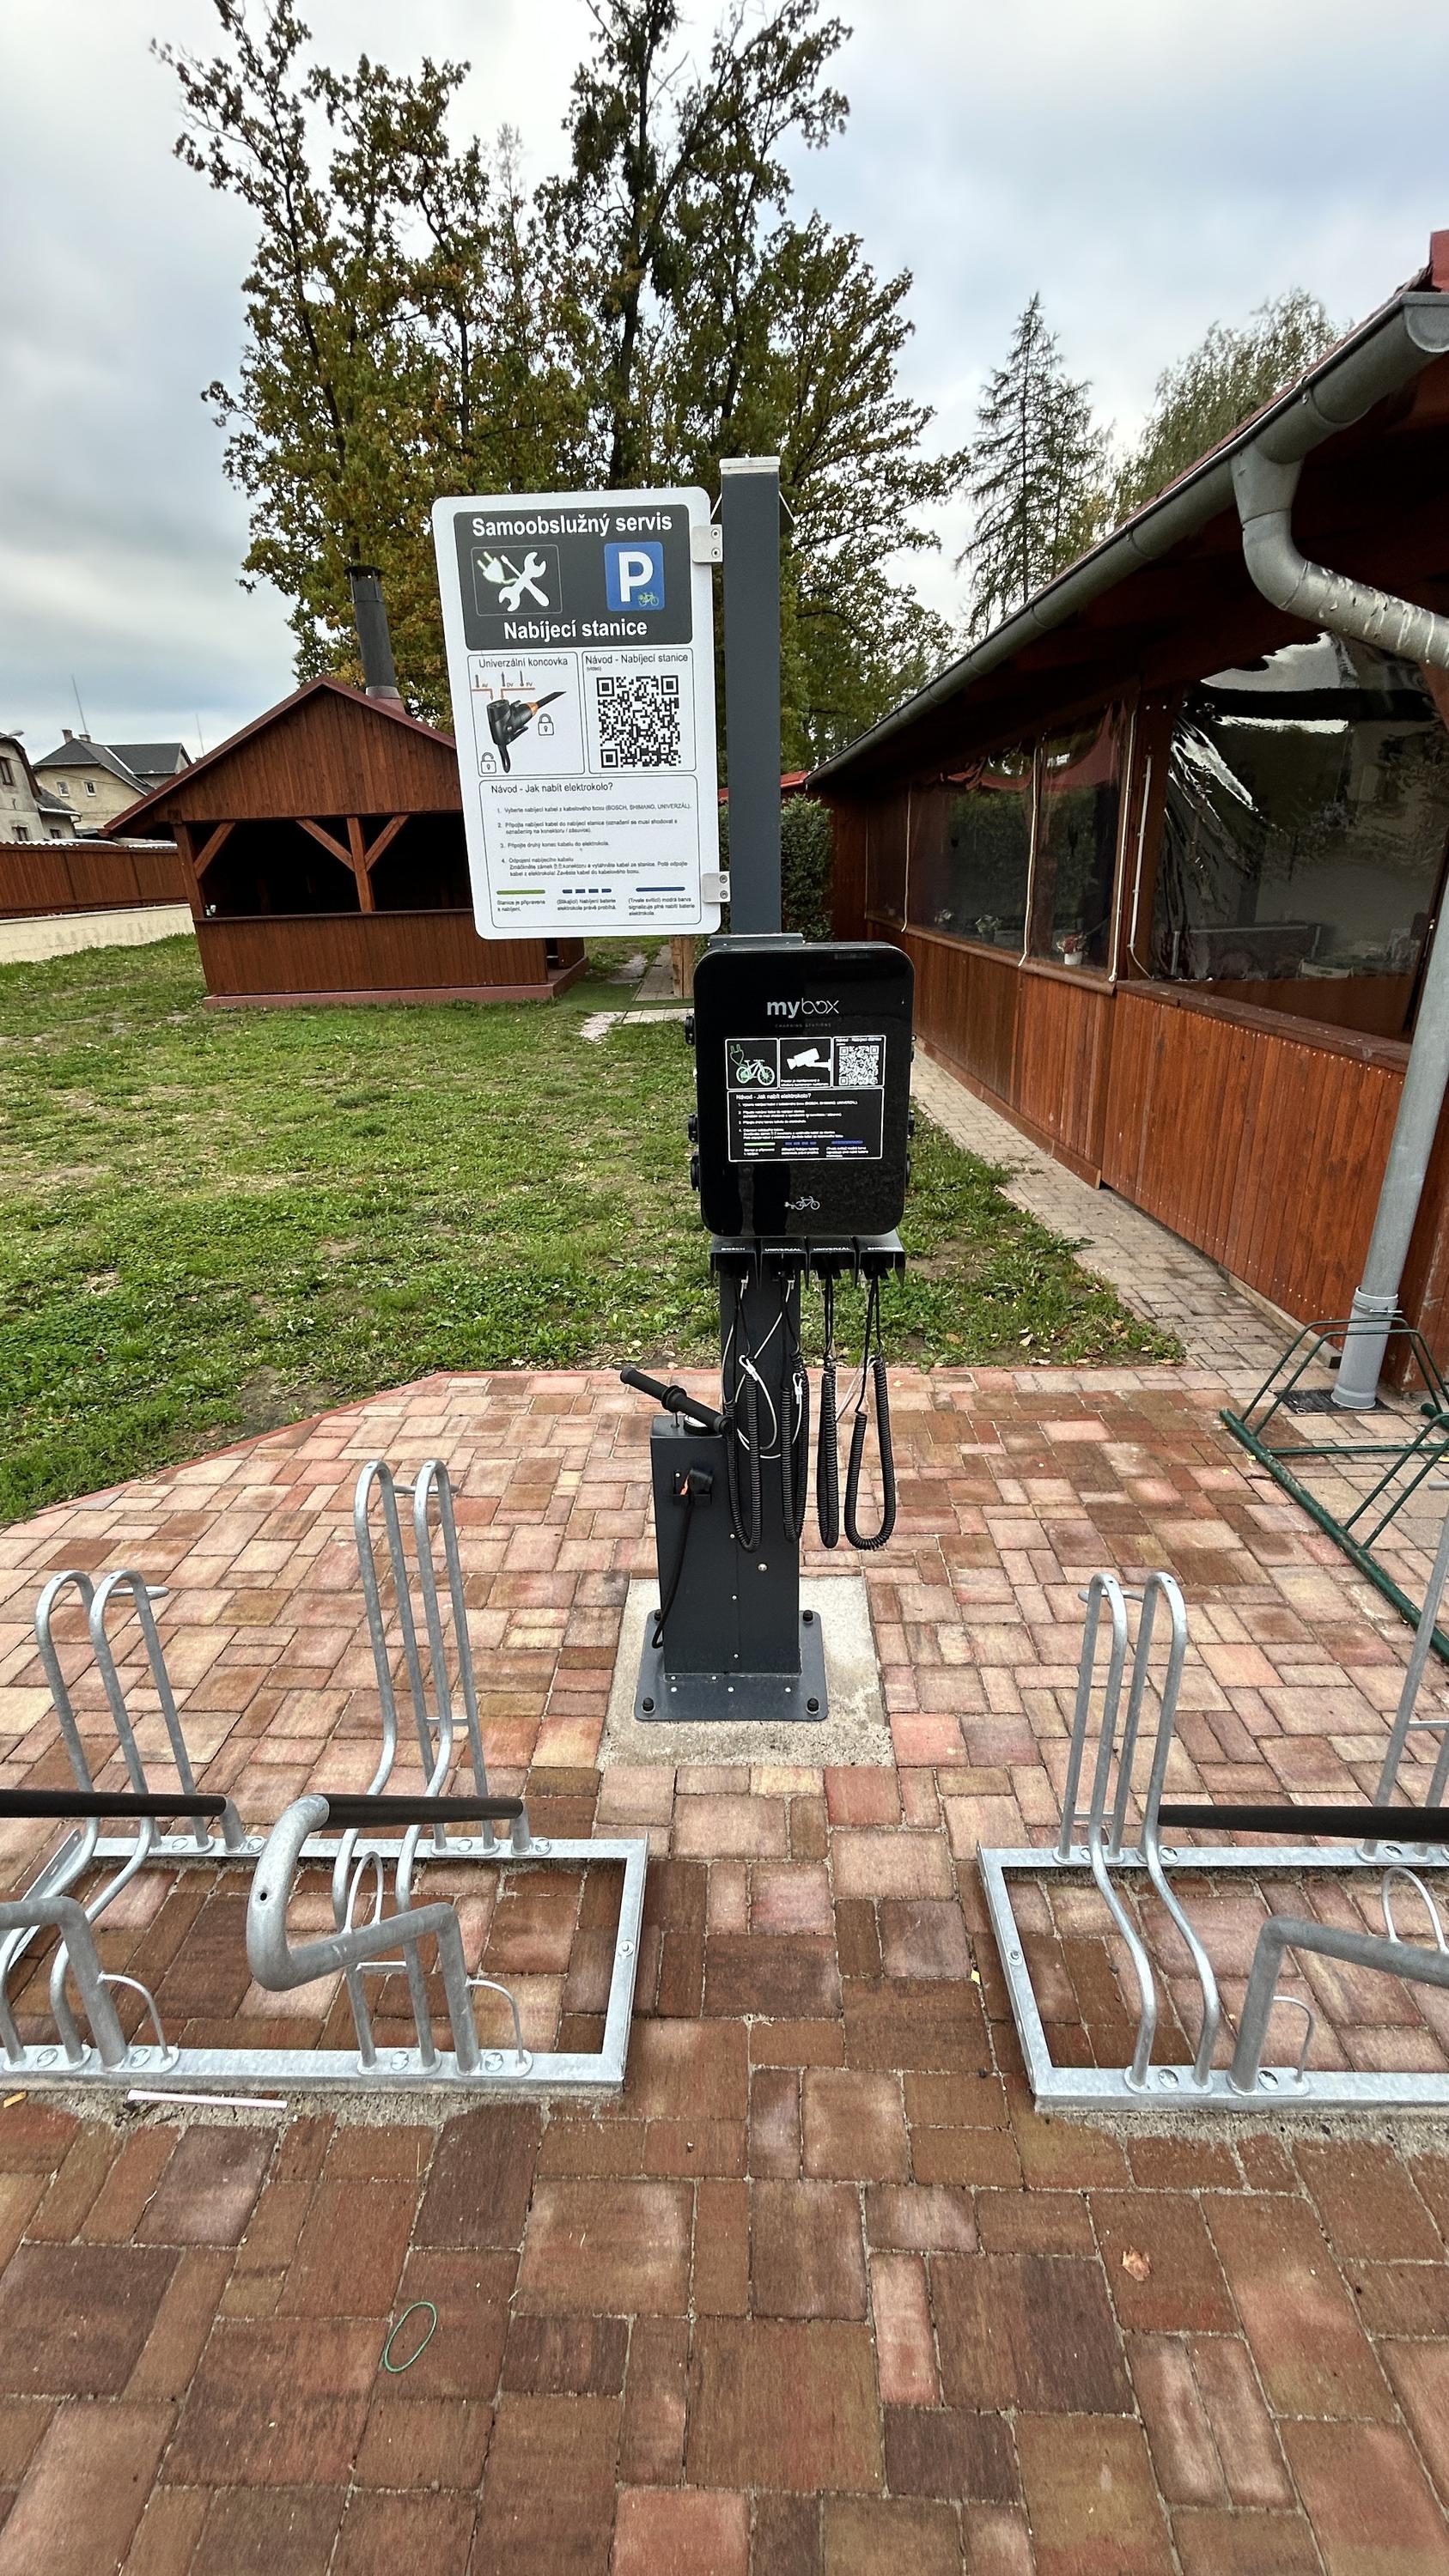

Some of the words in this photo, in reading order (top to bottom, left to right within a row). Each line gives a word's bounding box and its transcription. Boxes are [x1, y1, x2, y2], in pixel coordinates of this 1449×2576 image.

[472, 514, 609, 538] Samoobslužný
[615, 512, 673, 532] servis
[618, 551, 654, 603] P
[503, 619, 577, 643] Nabíjecí
[581, 618, 648, 638] stanice
[478, 658, 526, 668] Univerzální
[528, 656, 568, 667] koncovka
[585, 655, 612, 665] Návod
[621, 653, 655, 665] Nabíjecí
[658, 653, 689, 663] stanice
[491, 784, 518, 793] Návod
[525, 784, 539, 793] Jak
[542, 783, 563, 793] nabít
[564, 782, 613, 792] elektrokolo?
[767, 997, 839, 1018] mybox
